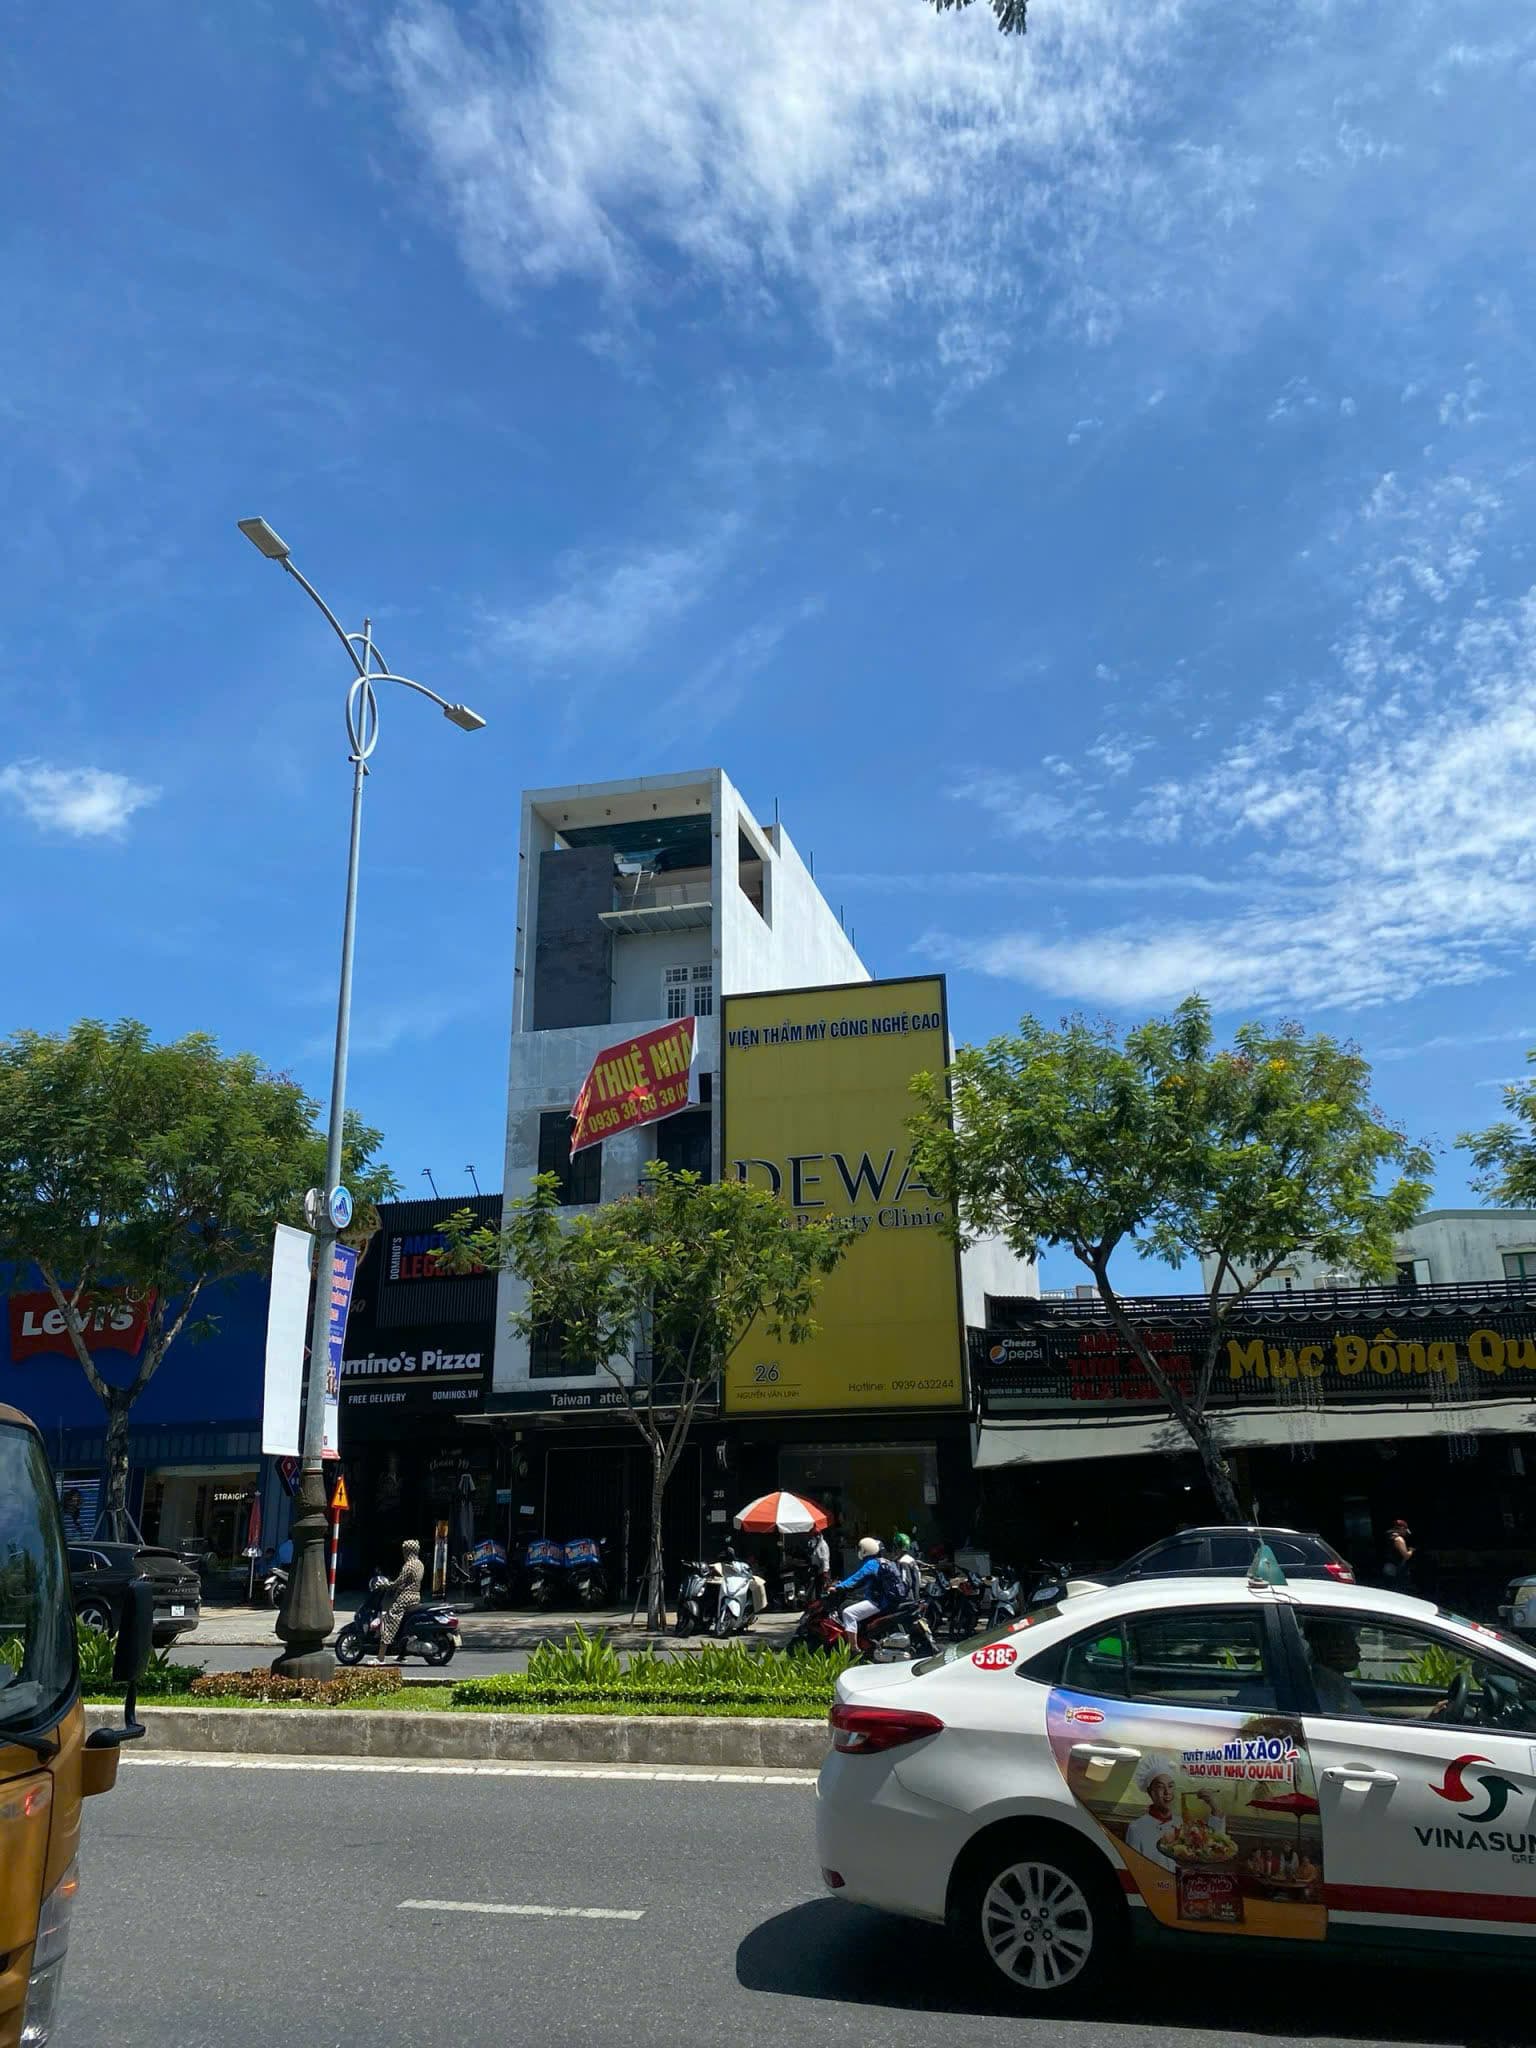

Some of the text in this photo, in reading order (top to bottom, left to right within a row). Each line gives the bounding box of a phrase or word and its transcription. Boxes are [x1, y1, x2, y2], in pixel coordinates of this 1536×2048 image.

[729, 1026, 759, 1050] VIỆN
[830, 1017, 868, 1037] CÔNG
[872, 1011, 908, 1035] NGHỆ
[912, 1013, 940, 1030] CAO
[594, 1043, 650, 1101] THUÊ
[588, 1107, 620, 1133] 0936
[620, 1099, 638, 1120] 38
[659, 1086, 676, 1107] 38
[732, 1148, 944, 1208] DEWA
[879, 1207, 944, 1227] Clinic
[389, 1236, 402, 1280] DOMINO'S
[1001, 1338, 1037, 1347] Cheers
[421, 1348, 481, 1371] Pizza
[1008, 1347, 1042, 1361] pepsi
[1334, 1328, 1458, 1384] Đồng
[754, 1364, 779, 1383] 26
[891, 1380, 916, 1391] 0939
[348, 1394, 368, 1404] FREE
[369, 1392, 407, 1404] DELIVERY
[432, 1389, 479, 1400] DOMINOS.VN
[550, 1392, 591, 1406] Taiwan
[975, 1648, 1016, 1665] 5385
[1224, 1739, 1242, 1761] MÌ
[1207, 1764, 1222, 1777] VUI
[1247, 1761, 1284, 1780] QUÁN
